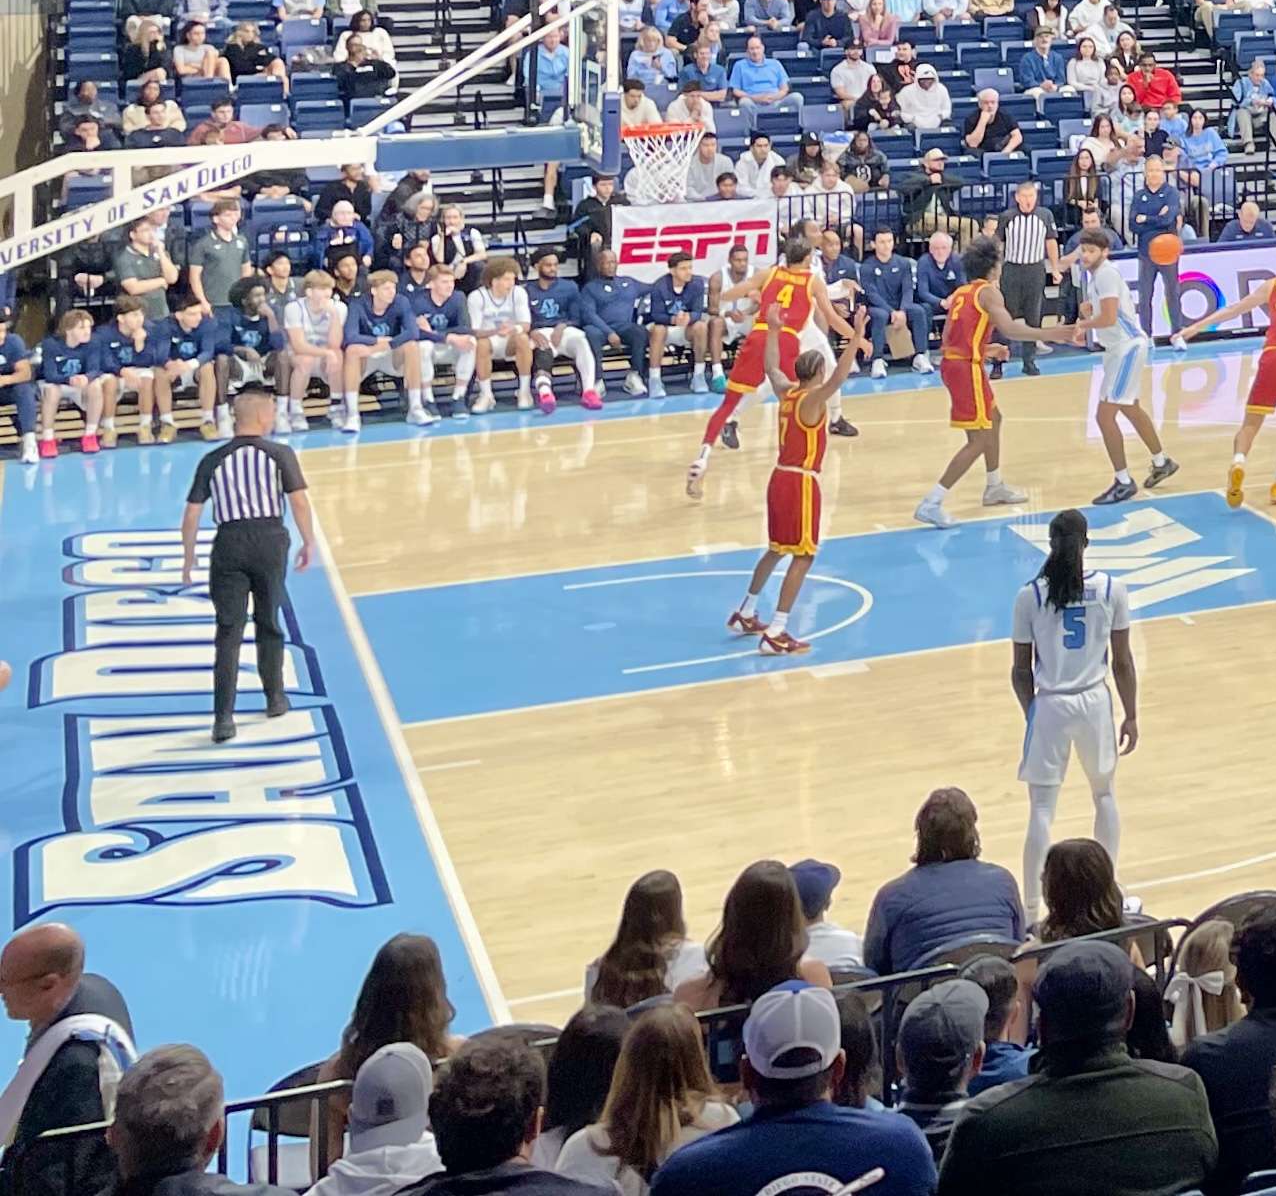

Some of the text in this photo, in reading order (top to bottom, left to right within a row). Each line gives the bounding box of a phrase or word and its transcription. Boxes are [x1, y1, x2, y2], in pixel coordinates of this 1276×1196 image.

[0, 154, 253, 265] VERSITY OF SAN DIEGO
[618, 220, 771, 265] ESPN
[776, 284, 795, 309] 4
[951, 295, 966, 321] 2
[1063, 606, 1087, 650] 5
